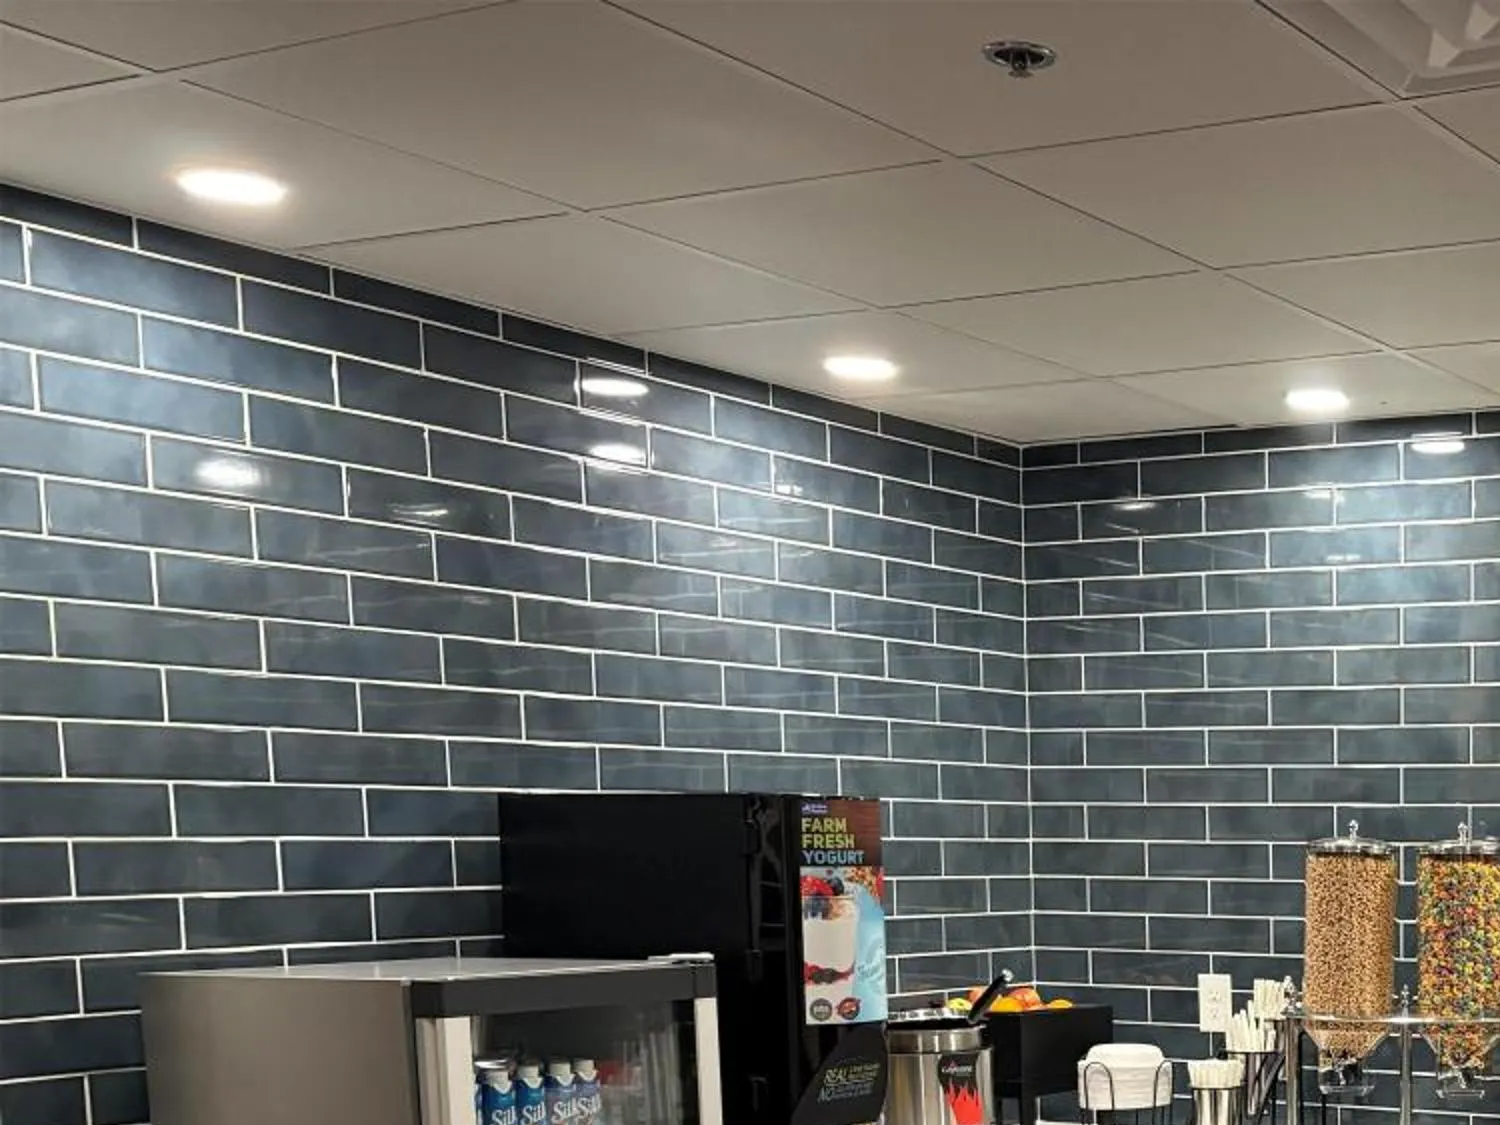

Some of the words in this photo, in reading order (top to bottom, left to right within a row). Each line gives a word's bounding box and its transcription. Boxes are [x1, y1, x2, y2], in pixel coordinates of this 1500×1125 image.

[801, 817, 847, 832] FARM
[802, 833, 855, 849] FRESH
[803, 850, 865, 865] YOGURT
